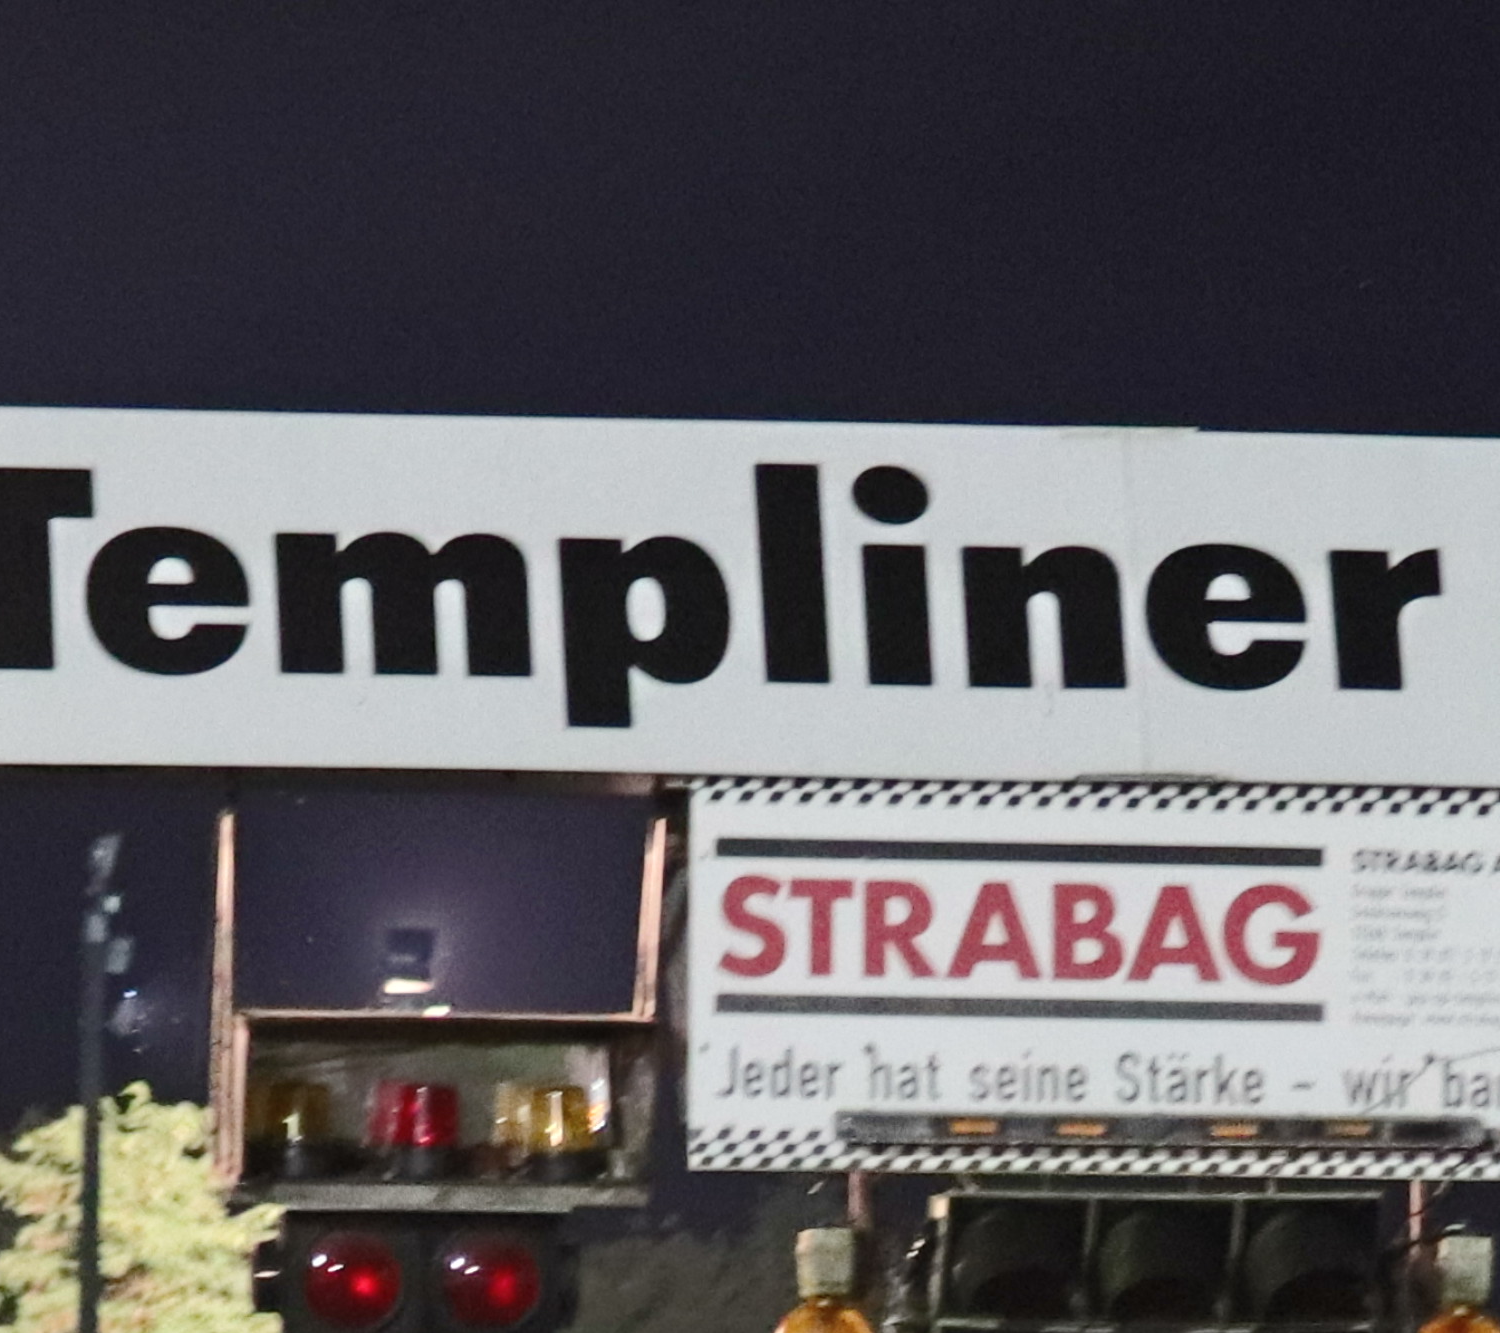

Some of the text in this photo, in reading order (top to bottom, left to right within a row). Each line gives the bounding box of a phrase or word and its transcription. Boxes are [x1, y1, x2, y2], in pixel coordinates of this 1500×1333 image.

[717, 874, 1322, 986] STRABAG
[717, 1042, 842, 1101] Jeder
[864, 1050, 941, 1101] hat
[968, 1048, 1090, 1104] seine
[1113, 1050, 1265, 1106] Stärke
[1343, 1054, 1412, 1109] wir
